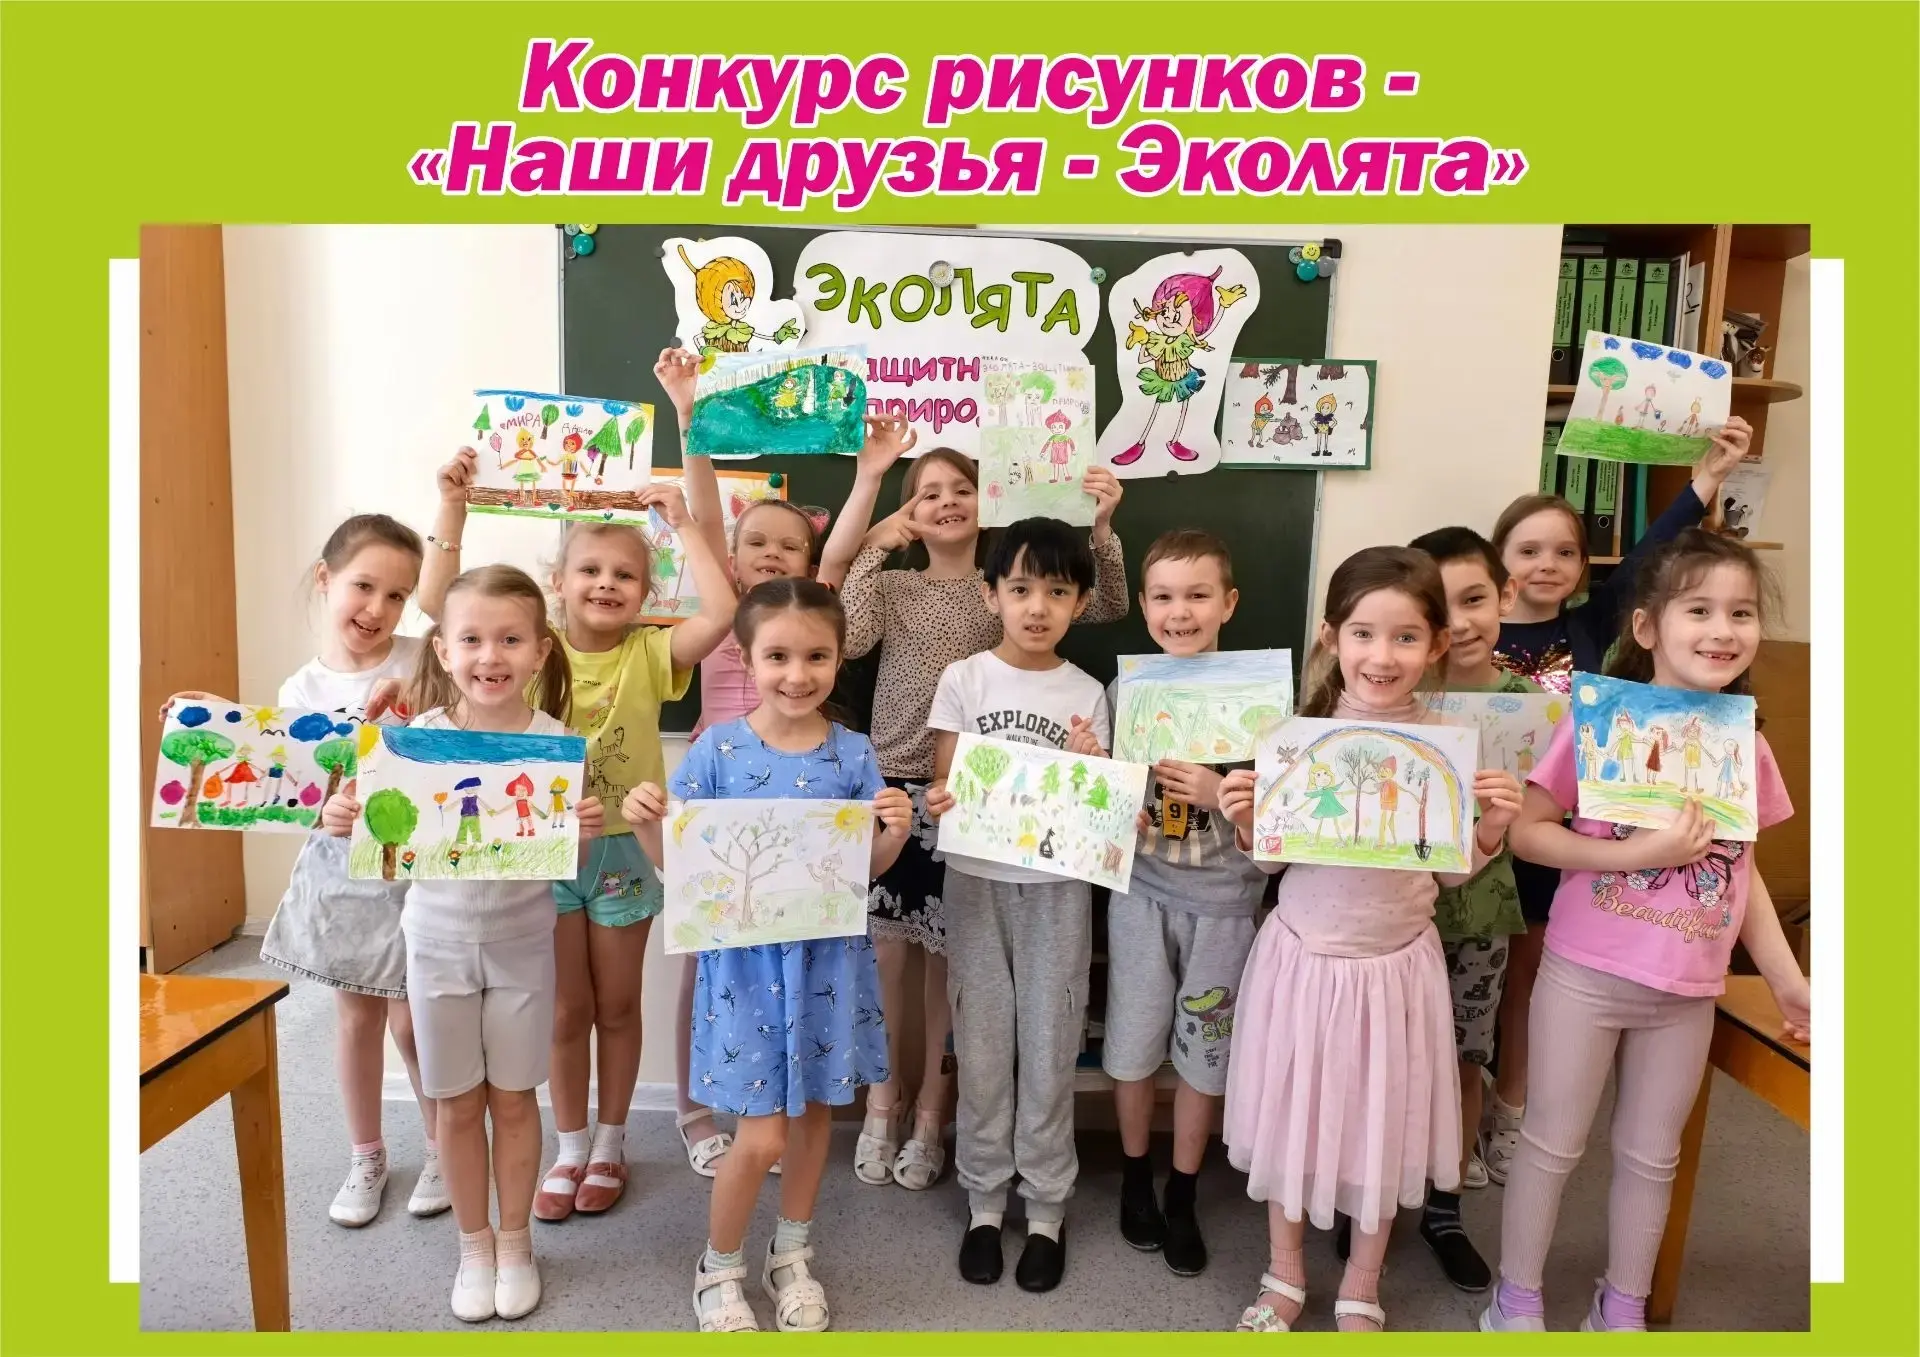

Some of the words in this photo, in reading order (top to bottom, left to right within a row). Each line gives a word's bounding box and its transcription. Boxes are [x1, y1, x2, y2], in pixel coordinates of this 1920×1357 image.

[867, 397, 980, 434] приро
[976, 709, 1070, 750] EXPLORER
[1169, 803, 1181, 819] 9
